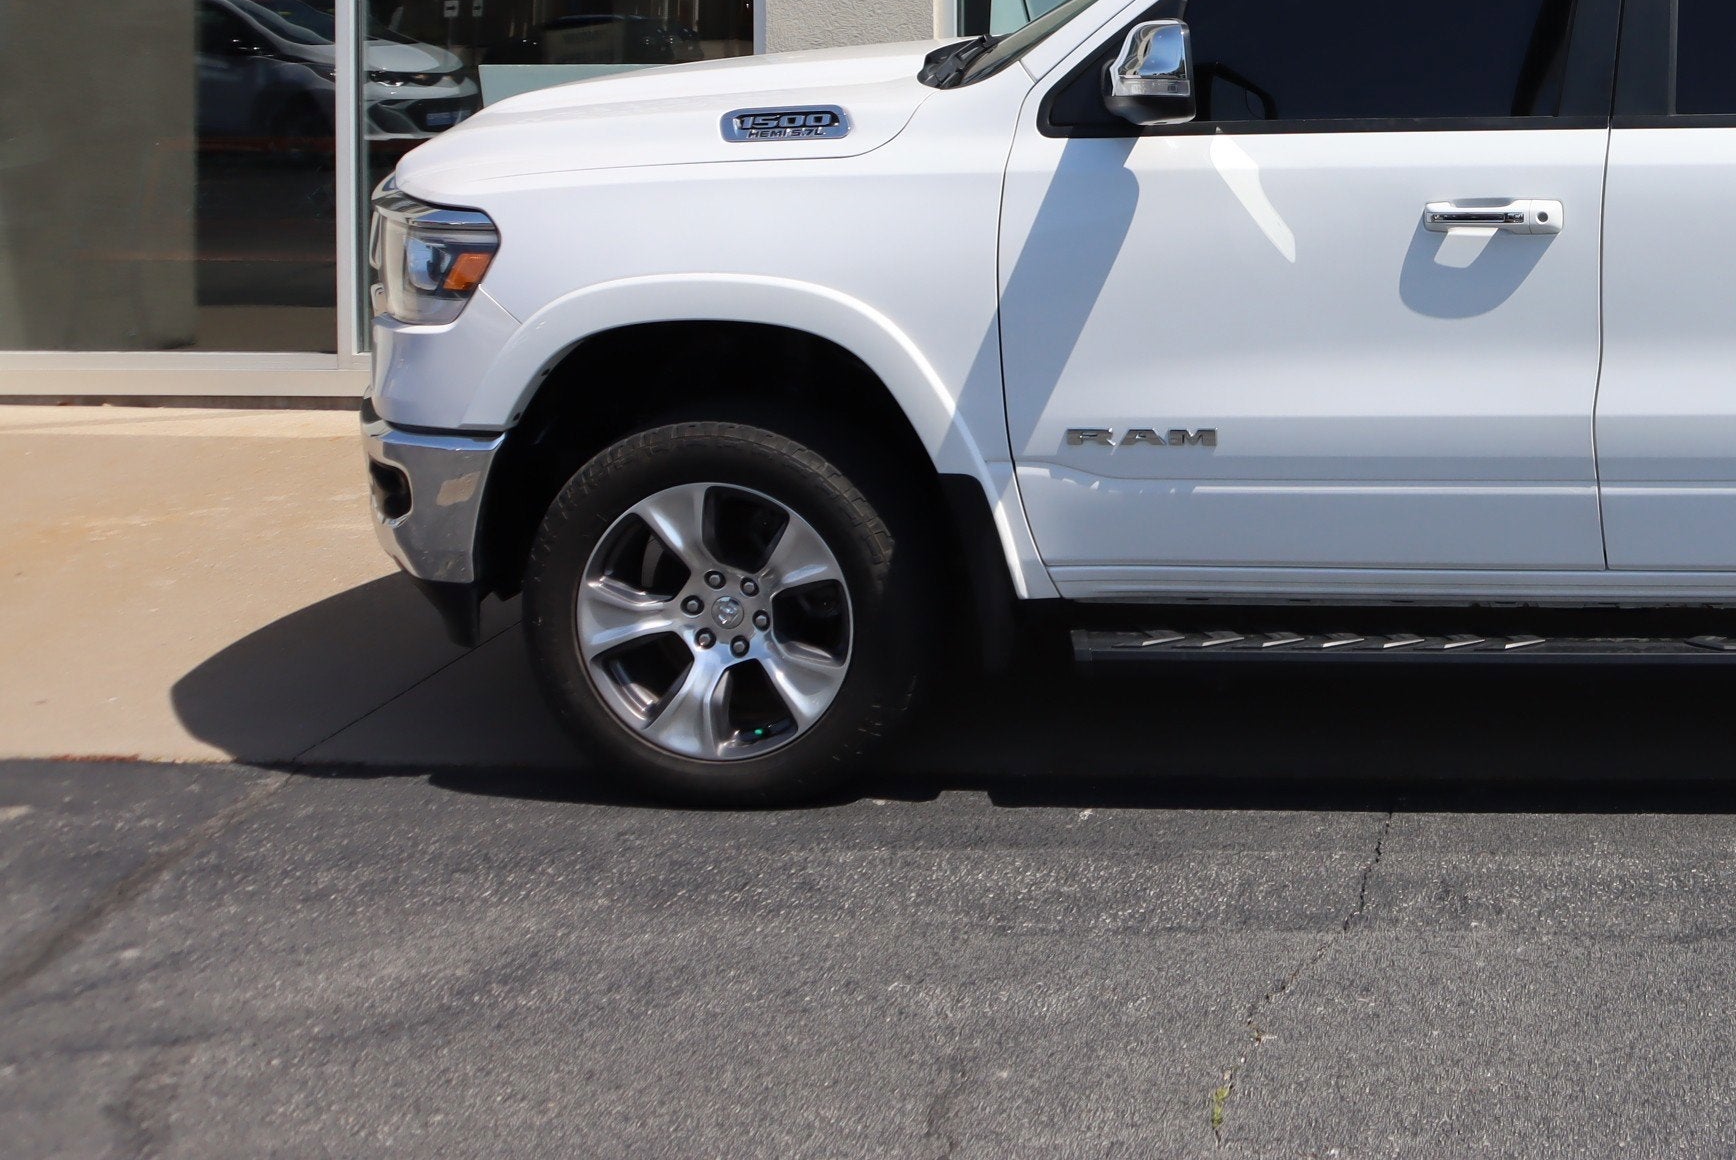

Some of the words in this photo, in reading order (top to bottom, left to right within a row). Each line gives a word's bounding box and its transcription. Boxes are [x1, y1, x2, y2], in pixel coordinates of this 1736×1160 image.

[739, 113, 833, 129] 1500
[748, 130, 787, 138] HEMI
[1066, 428, 1218, 446] RAM
